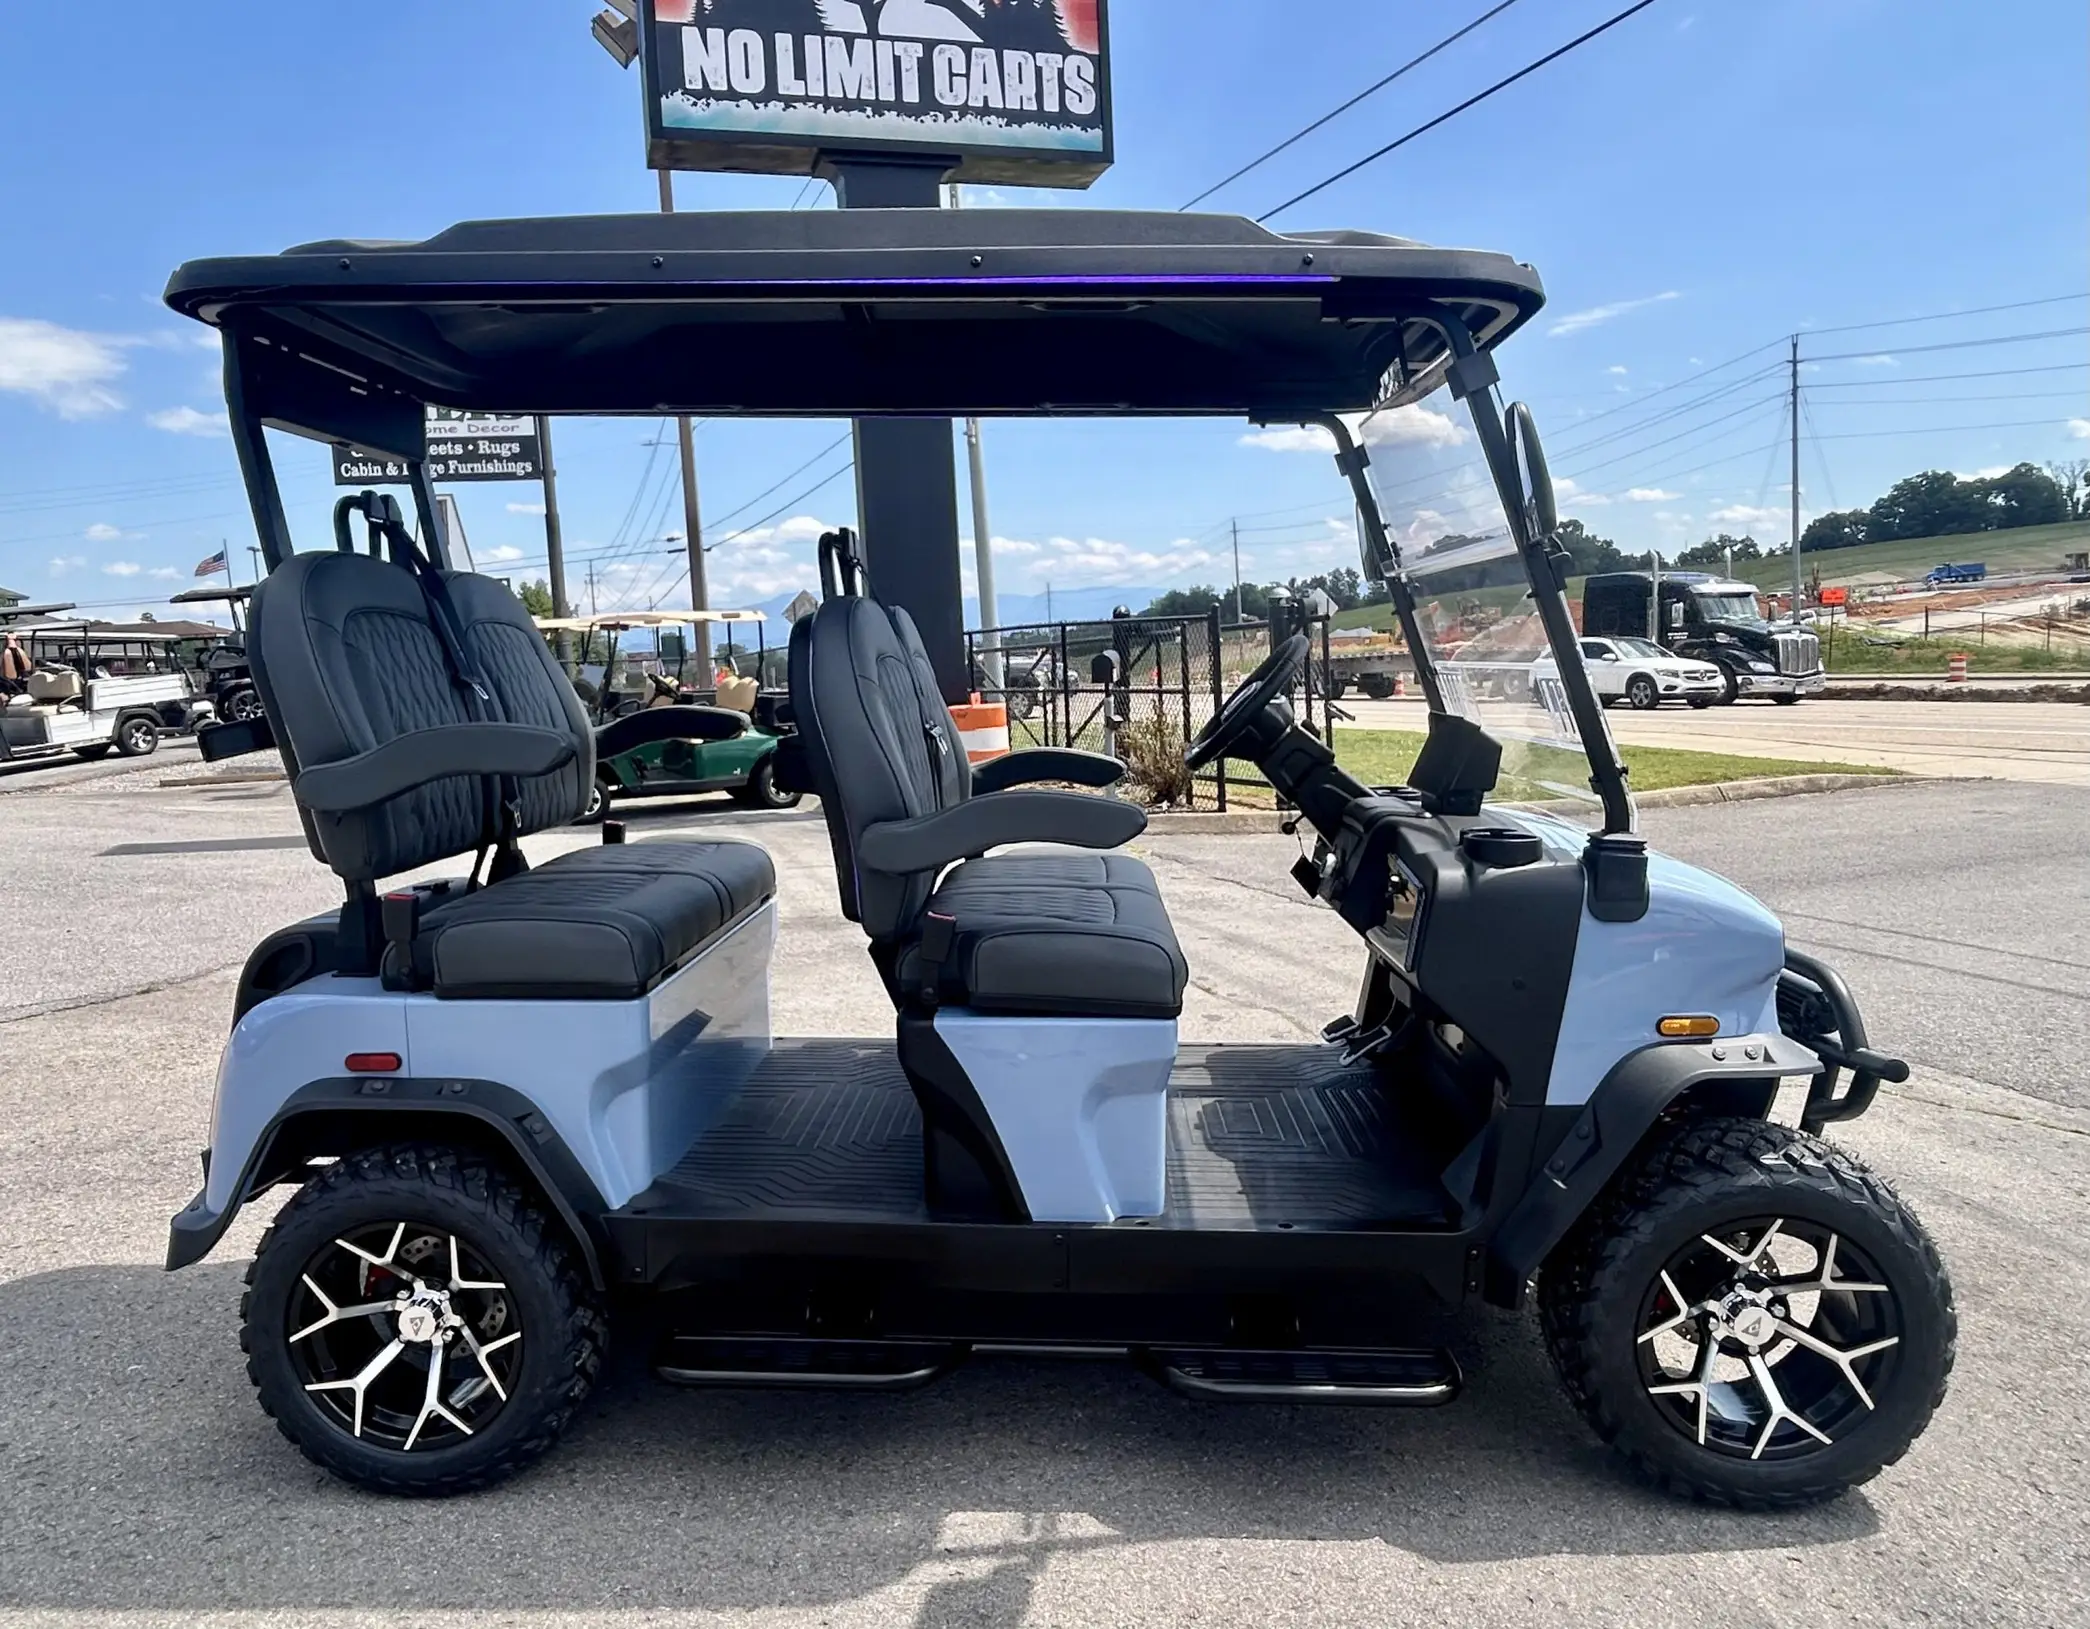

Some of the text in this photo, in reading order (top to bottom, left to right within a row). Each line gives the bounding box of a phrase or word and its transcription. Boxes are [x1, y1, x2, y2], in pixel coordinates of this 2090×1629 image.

[681, 25, 1097, 116] NO LIMIT CARTS
[425, 424, 520, 434] ome Decor
[477, 440, 521, 457] Rugs
[340, 462, 383, 478] Cabin
[386, 461, 399, 476] &
[448, 459, 533, 476] Furnishings
